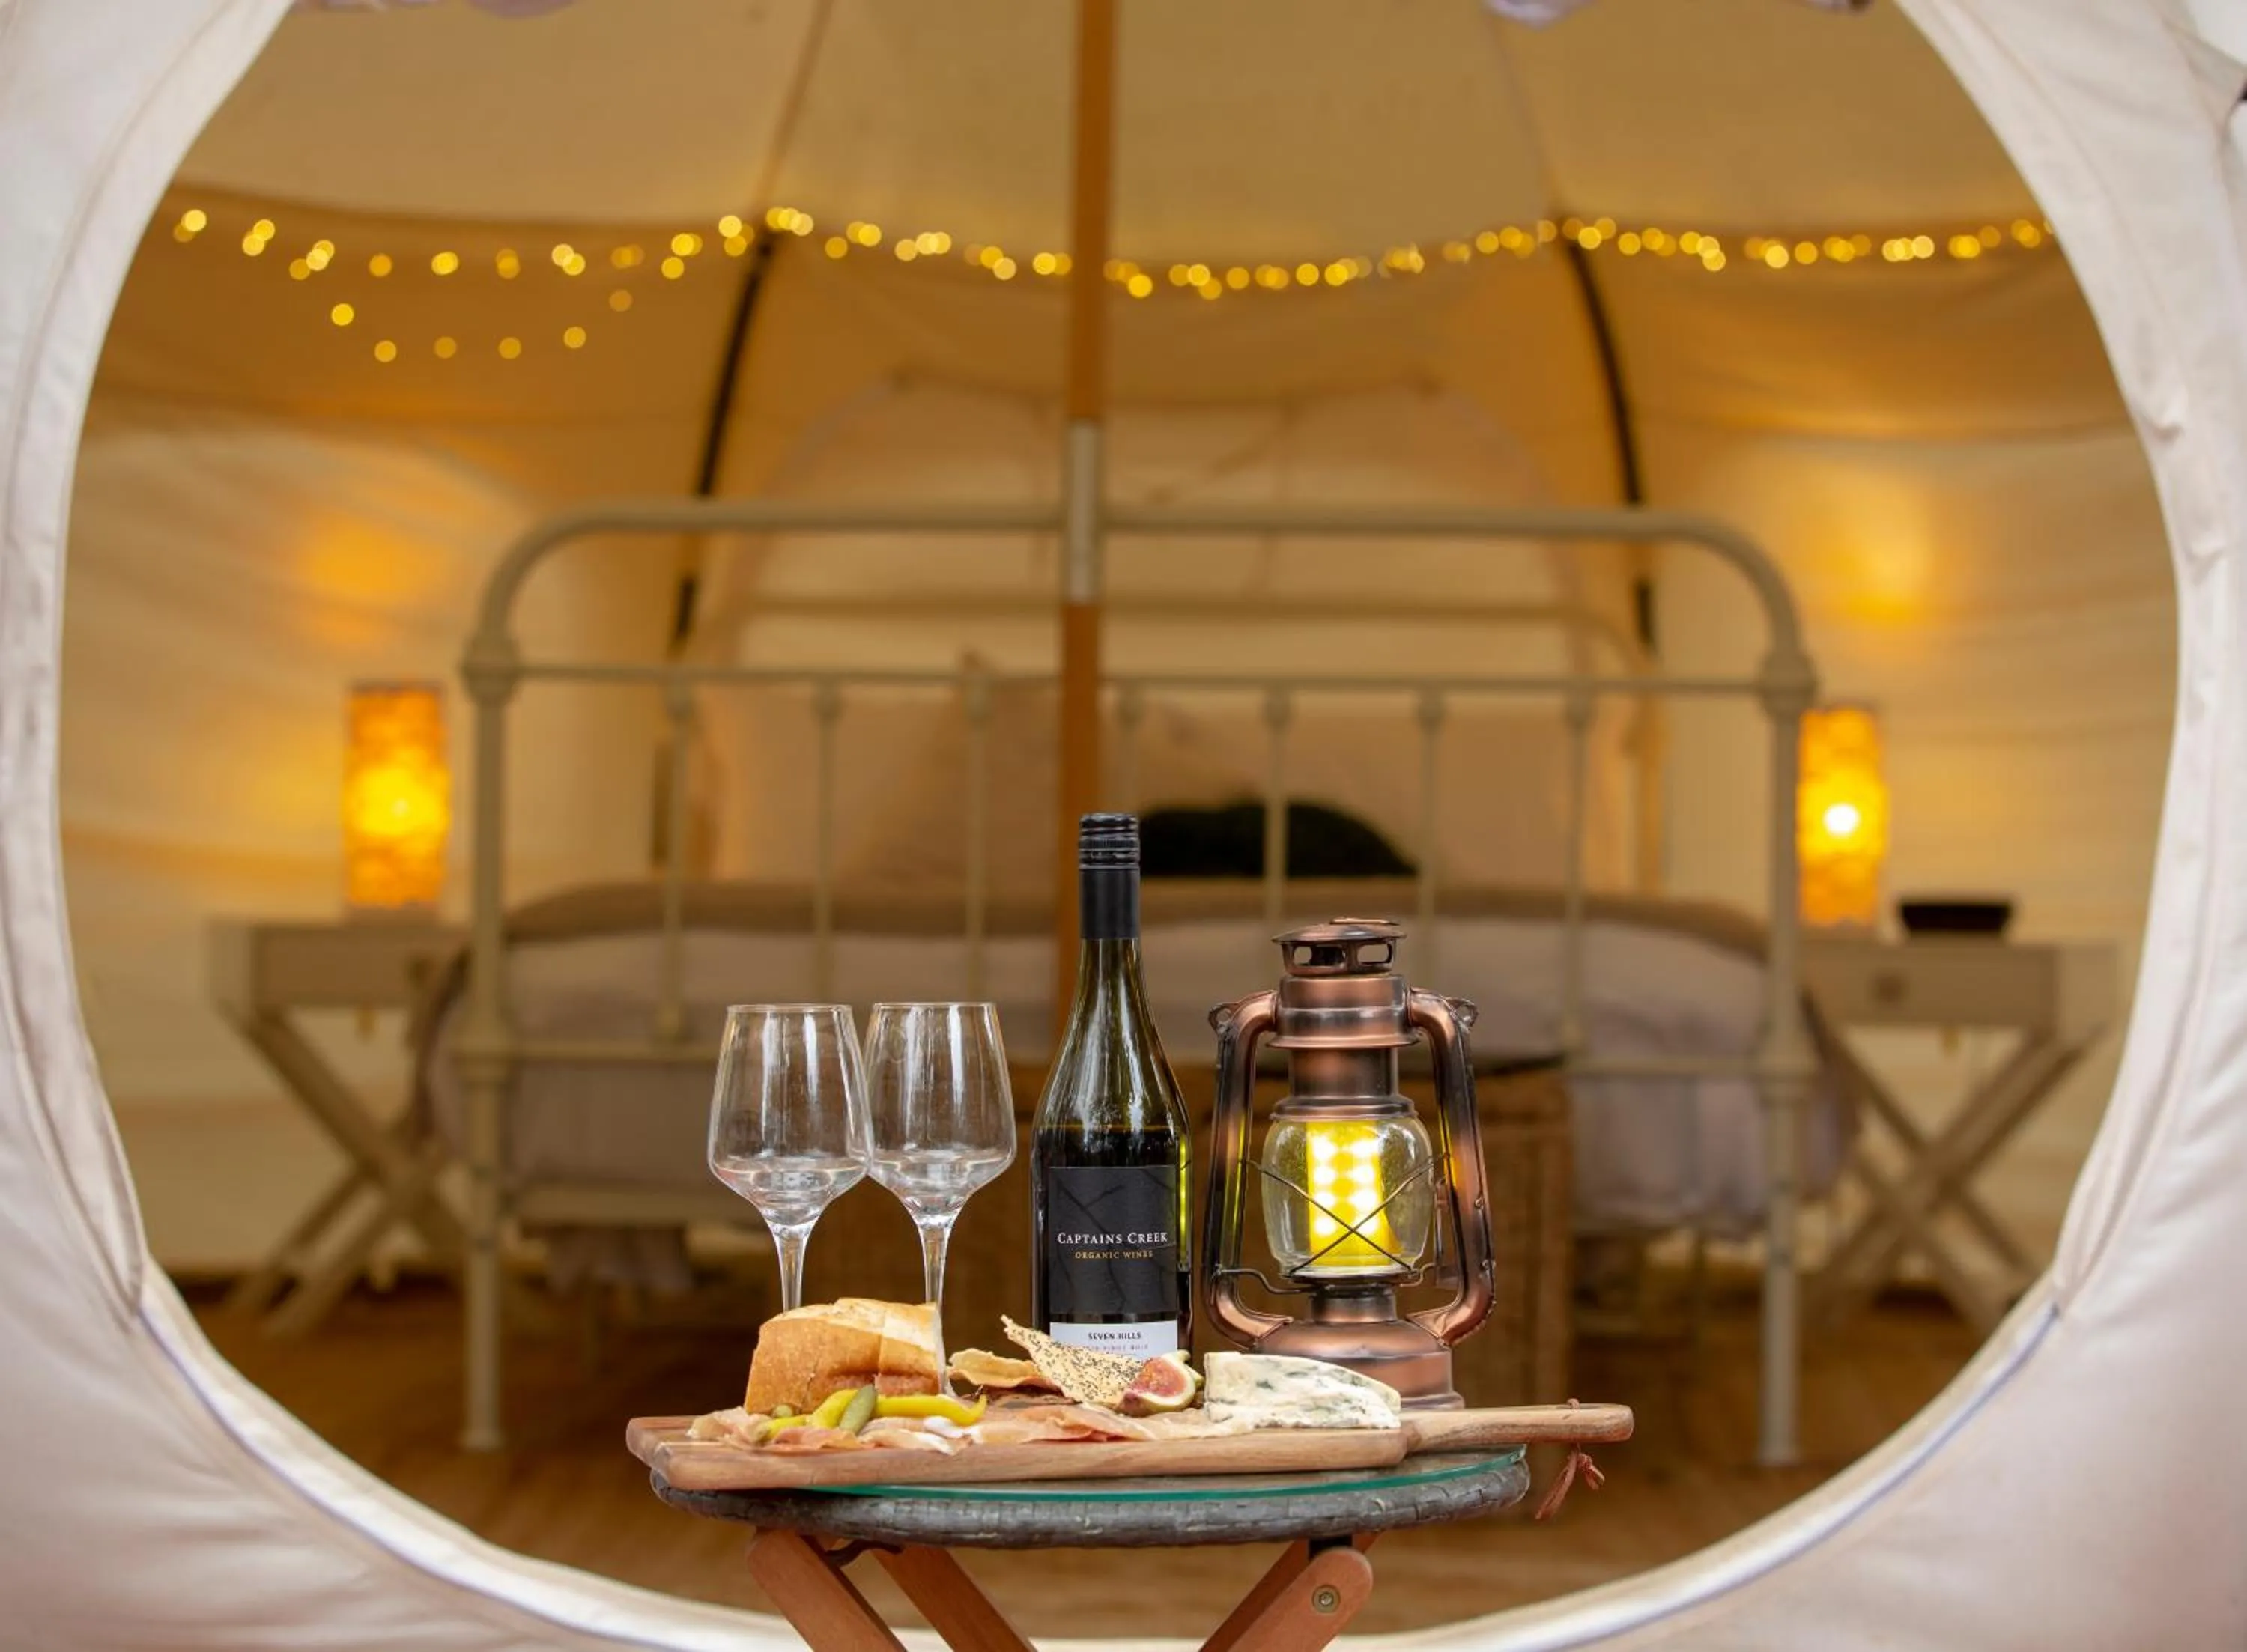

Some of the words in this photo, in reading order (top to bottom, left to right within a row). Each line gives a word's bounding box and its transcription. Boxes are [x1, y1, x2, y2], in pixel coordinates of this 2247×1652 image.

[1057, 1232, 1123, 1244] CAPTAINS
[1127, 1231, 1168, 1243] CREEK
[1123, 1250, 1154, 1258] WINES
